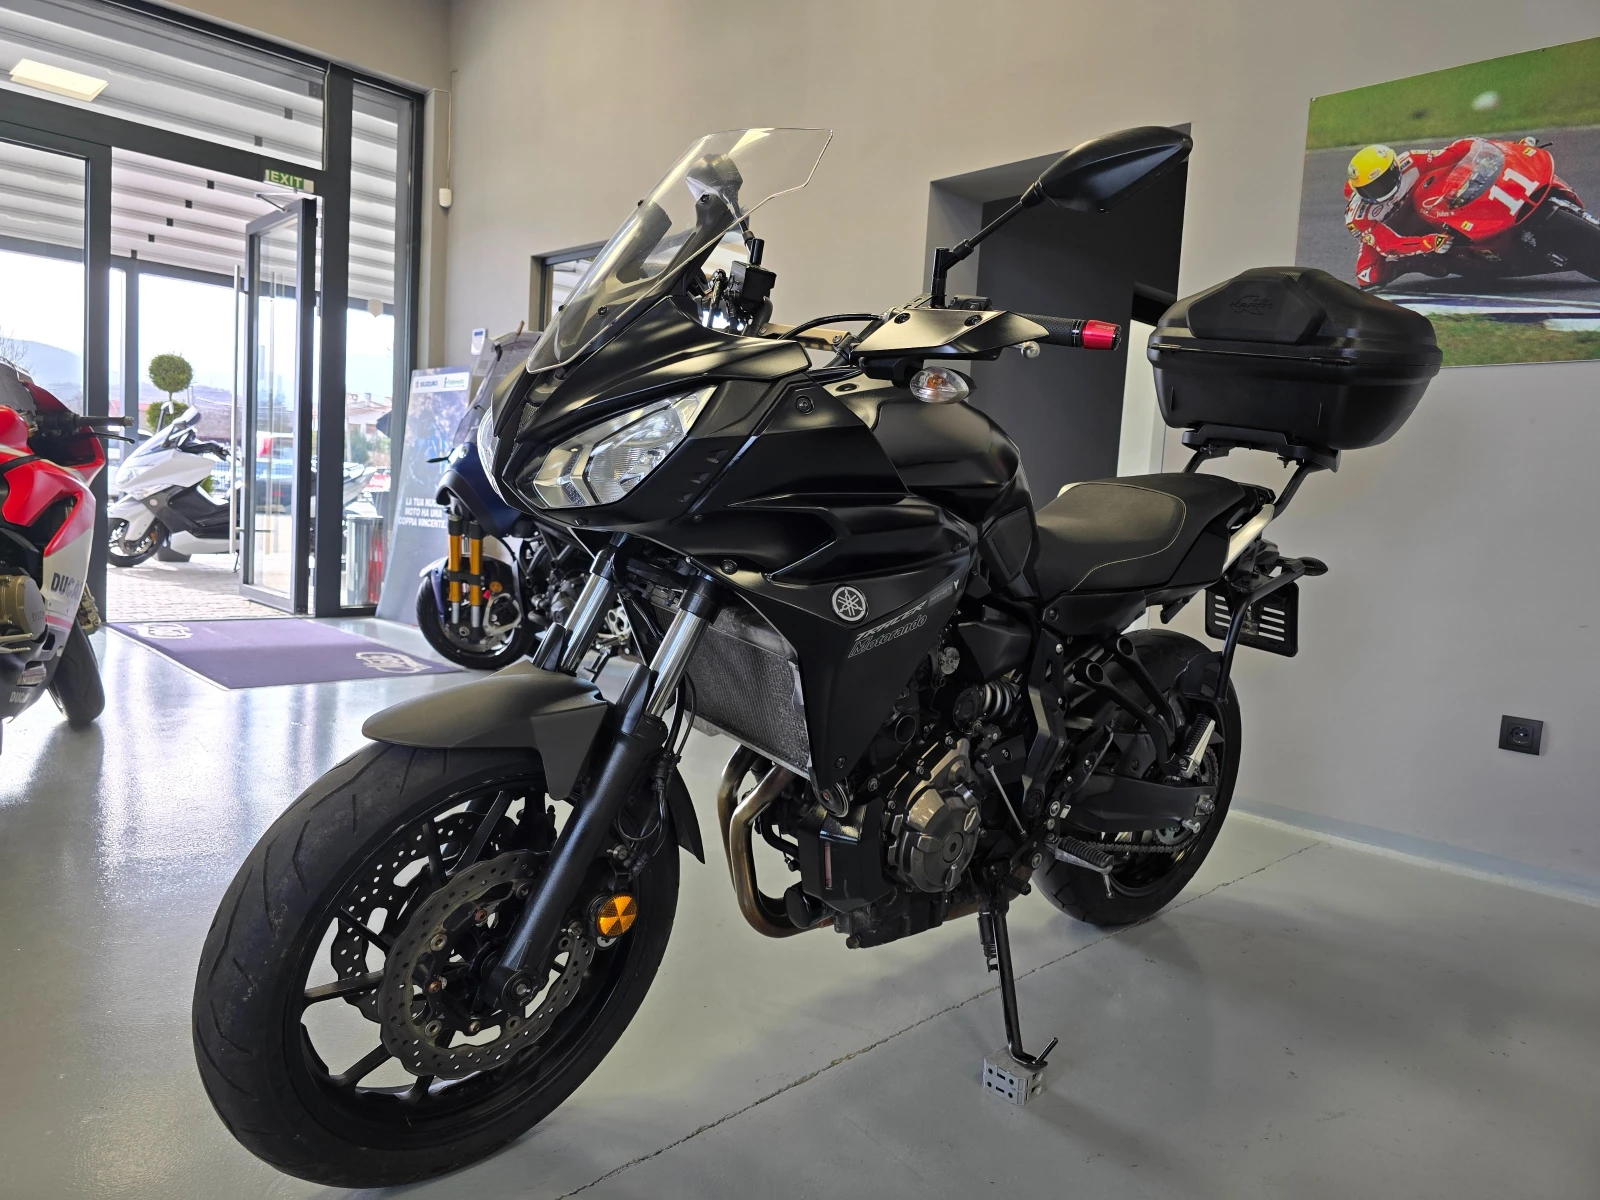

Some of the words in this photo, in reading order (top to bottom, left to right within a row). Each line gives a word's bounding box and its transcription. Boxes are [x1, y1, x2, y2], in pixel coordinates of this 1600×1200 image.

[270, 170, 302, 188] EXIT
[1488, 168, 1540, 216] 11
[405, 497, 413, 506] LA
[413, 497, 425, 507] TUA
[405, 507, 420, 517] MOTO
[421, 508, 430, 517] HA
[430, 509, 442, 518] UNA
[398, 516, 417, 527] COPPIA
[848, 614, 928, 658] Motorando
